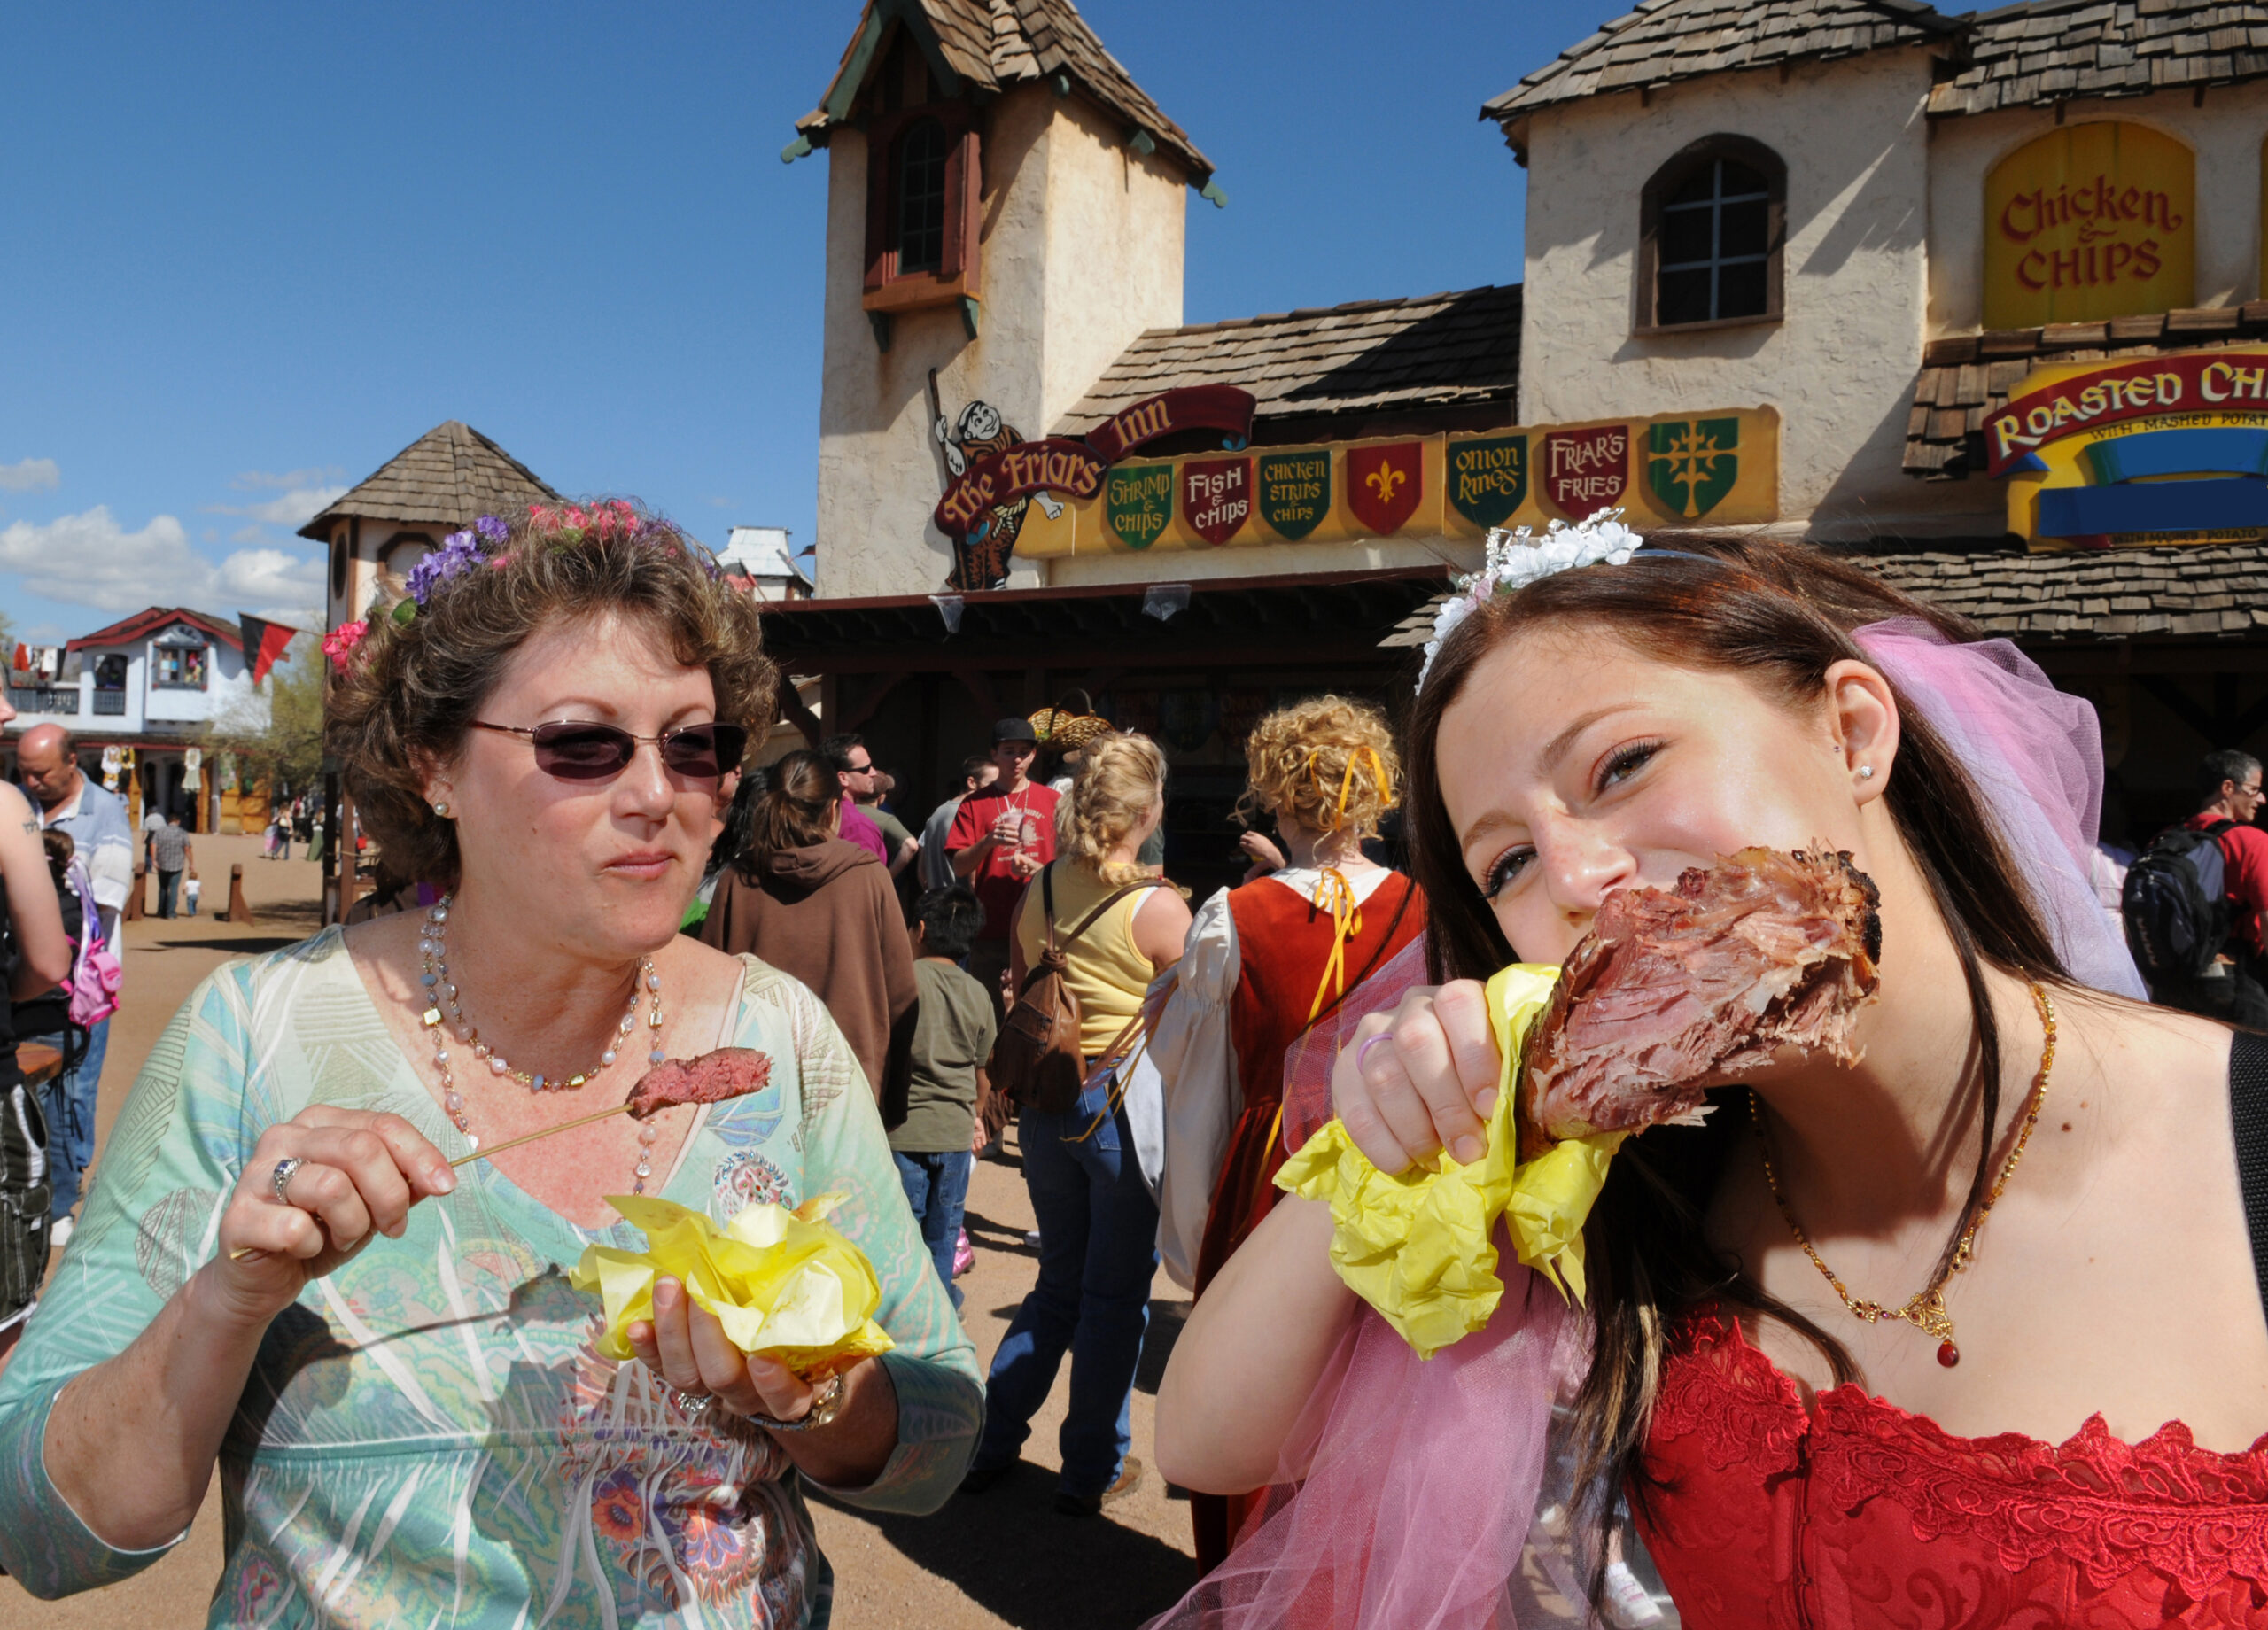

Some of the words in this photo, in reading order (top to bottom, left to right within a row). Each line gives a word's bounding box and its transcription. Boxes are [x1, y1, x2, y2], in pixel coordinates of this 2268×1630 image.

[2000, 174, 2184, 244] Chicken
[2078, 220, 2118, 244] &
[2016, 238, 2163, 291] CHIPS
[1993, 372, 2183, 460] ROASTED
[2201, 361, 2268, 402] CH
[2089, 422, 2134, 441] WITH
[2144, 411, 2212, 431] MASHED
[944, 470, 996, 528] The
[1001, 444, 1106, 495] Friars
[1110, 399, 1175, 450] Inn
[1456, 446, 1521, 471] ONION
[1550, 432, 1626, 478] FRIAR'S
[1188, 466, 1243, 504] FISH
[1264, 460, 1326, 483] CHICKEN
[1458, 468, 1521, 505] RINGS
[1109, 472, 1170, 507] SHRIMP
[1270, 481, 1322, 501] STRIPS
[1557, 475, 1622, 502] FRIES
[1115, 512, 1165, 539] CHIPS
[1195, 499, 1249, 530] CHIPS
[1272, 506, 1314, 523] CHIPS
